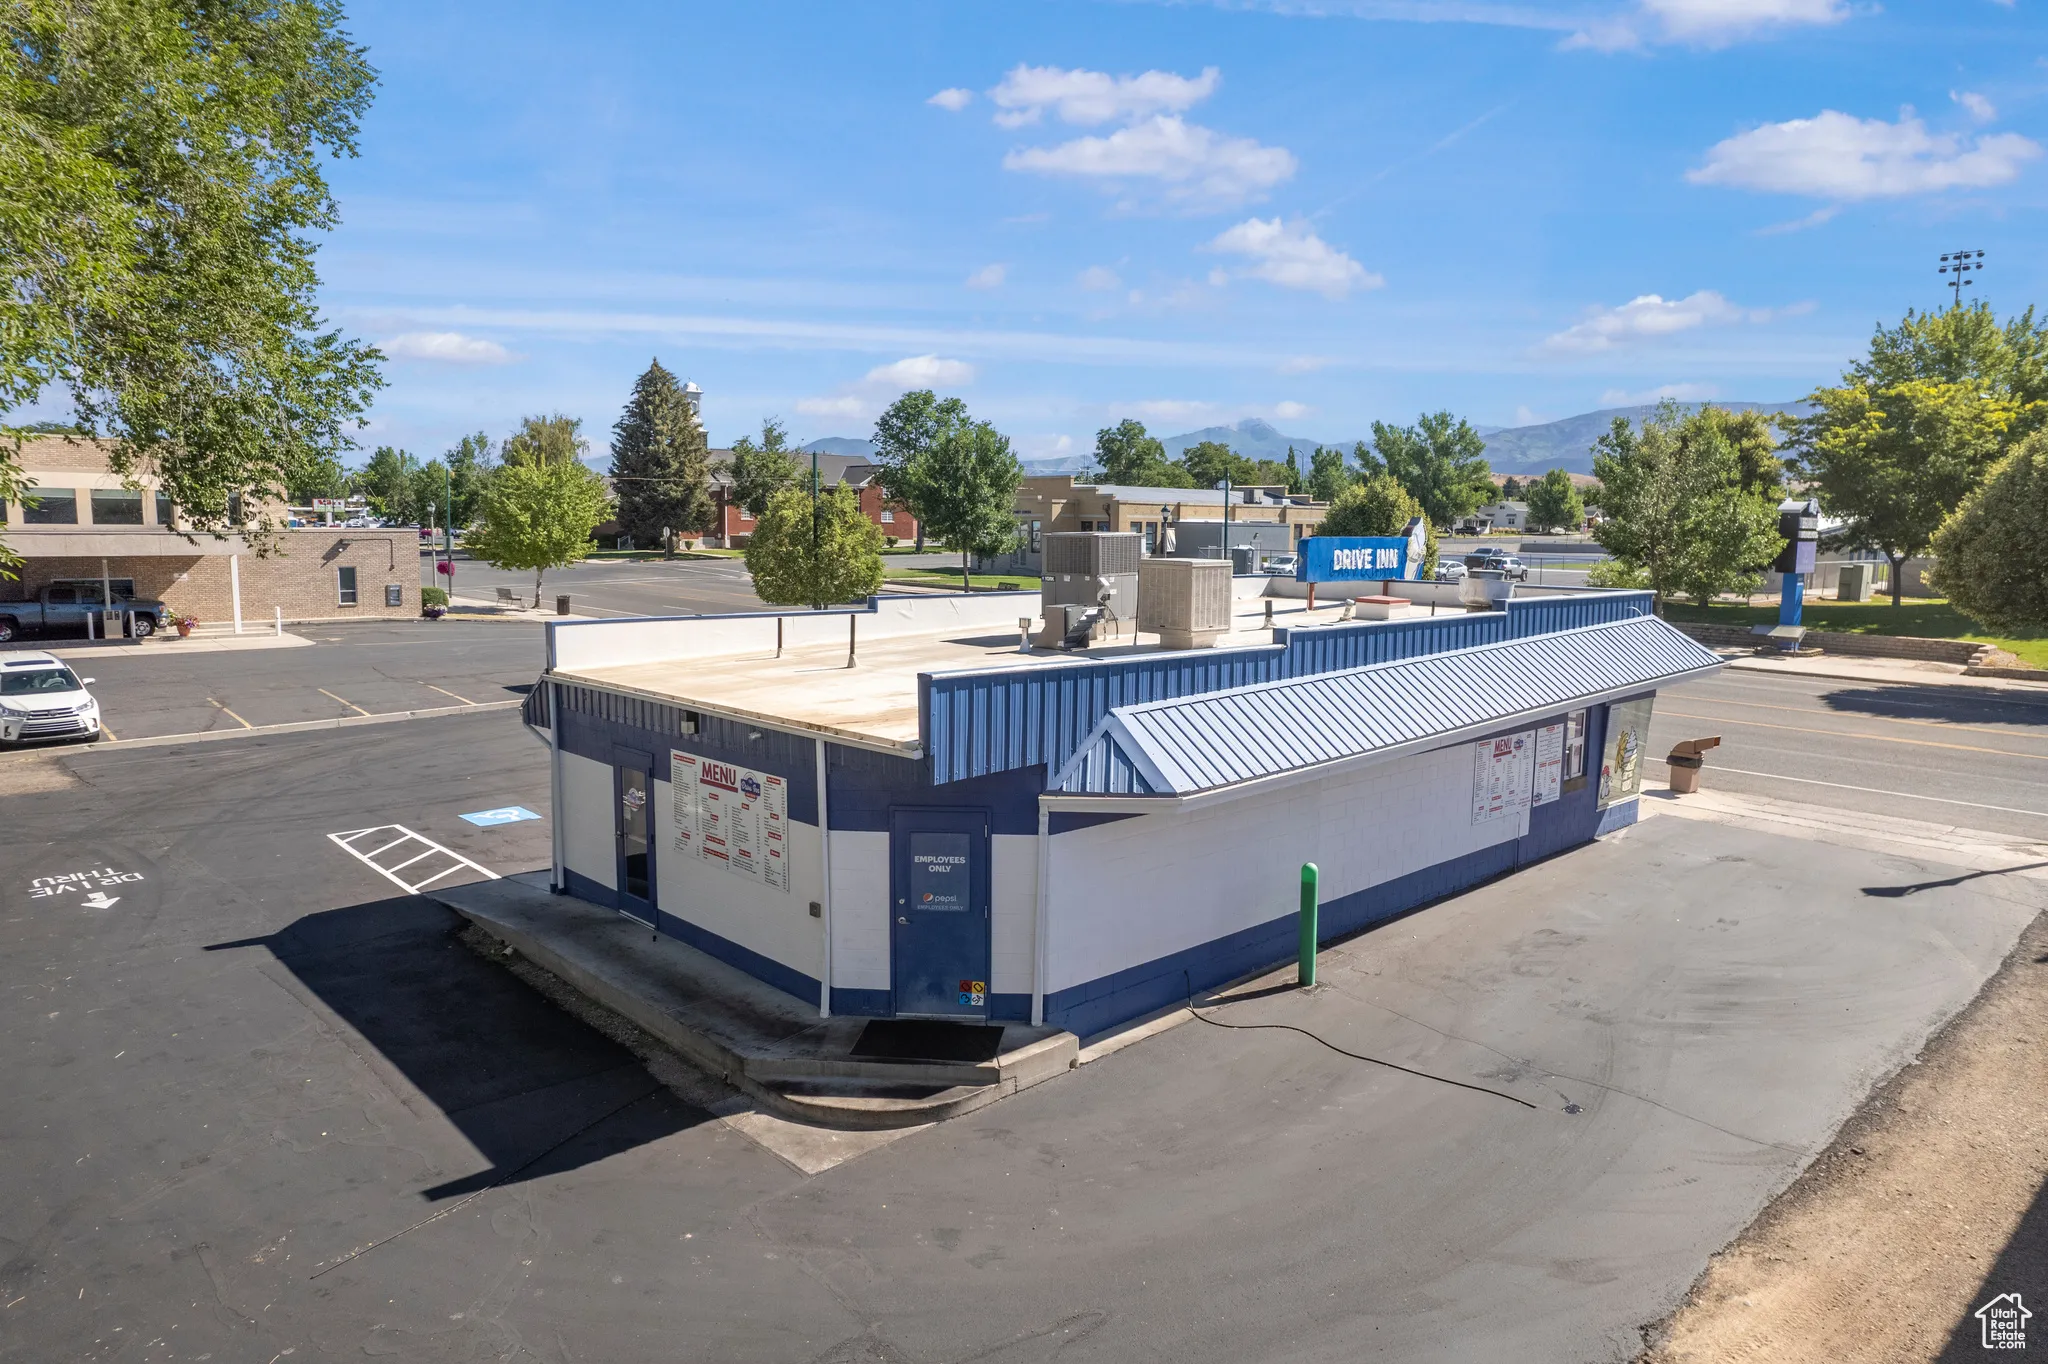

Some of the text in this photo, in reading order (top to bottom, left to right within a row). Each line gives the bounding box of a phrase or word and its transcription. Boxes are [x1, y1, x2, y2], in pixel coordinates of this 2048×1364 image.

[1333, 548, 1373, 570] DRIVE
[1376, 548, 1398, 569] INN
[1494, 738, 1512, 754] MENU
[702, 761, 736, 785] MENU
[914, 855, 966, 864] EMPLOYEES
[928, 865, 951, 873] ONLY
[28, 872, 145, 899] DRIVE
[32, 867, 123, 888] THRU
[934, 895, 957, 903] pepsi
[960, 993, 970, 1004] 3
